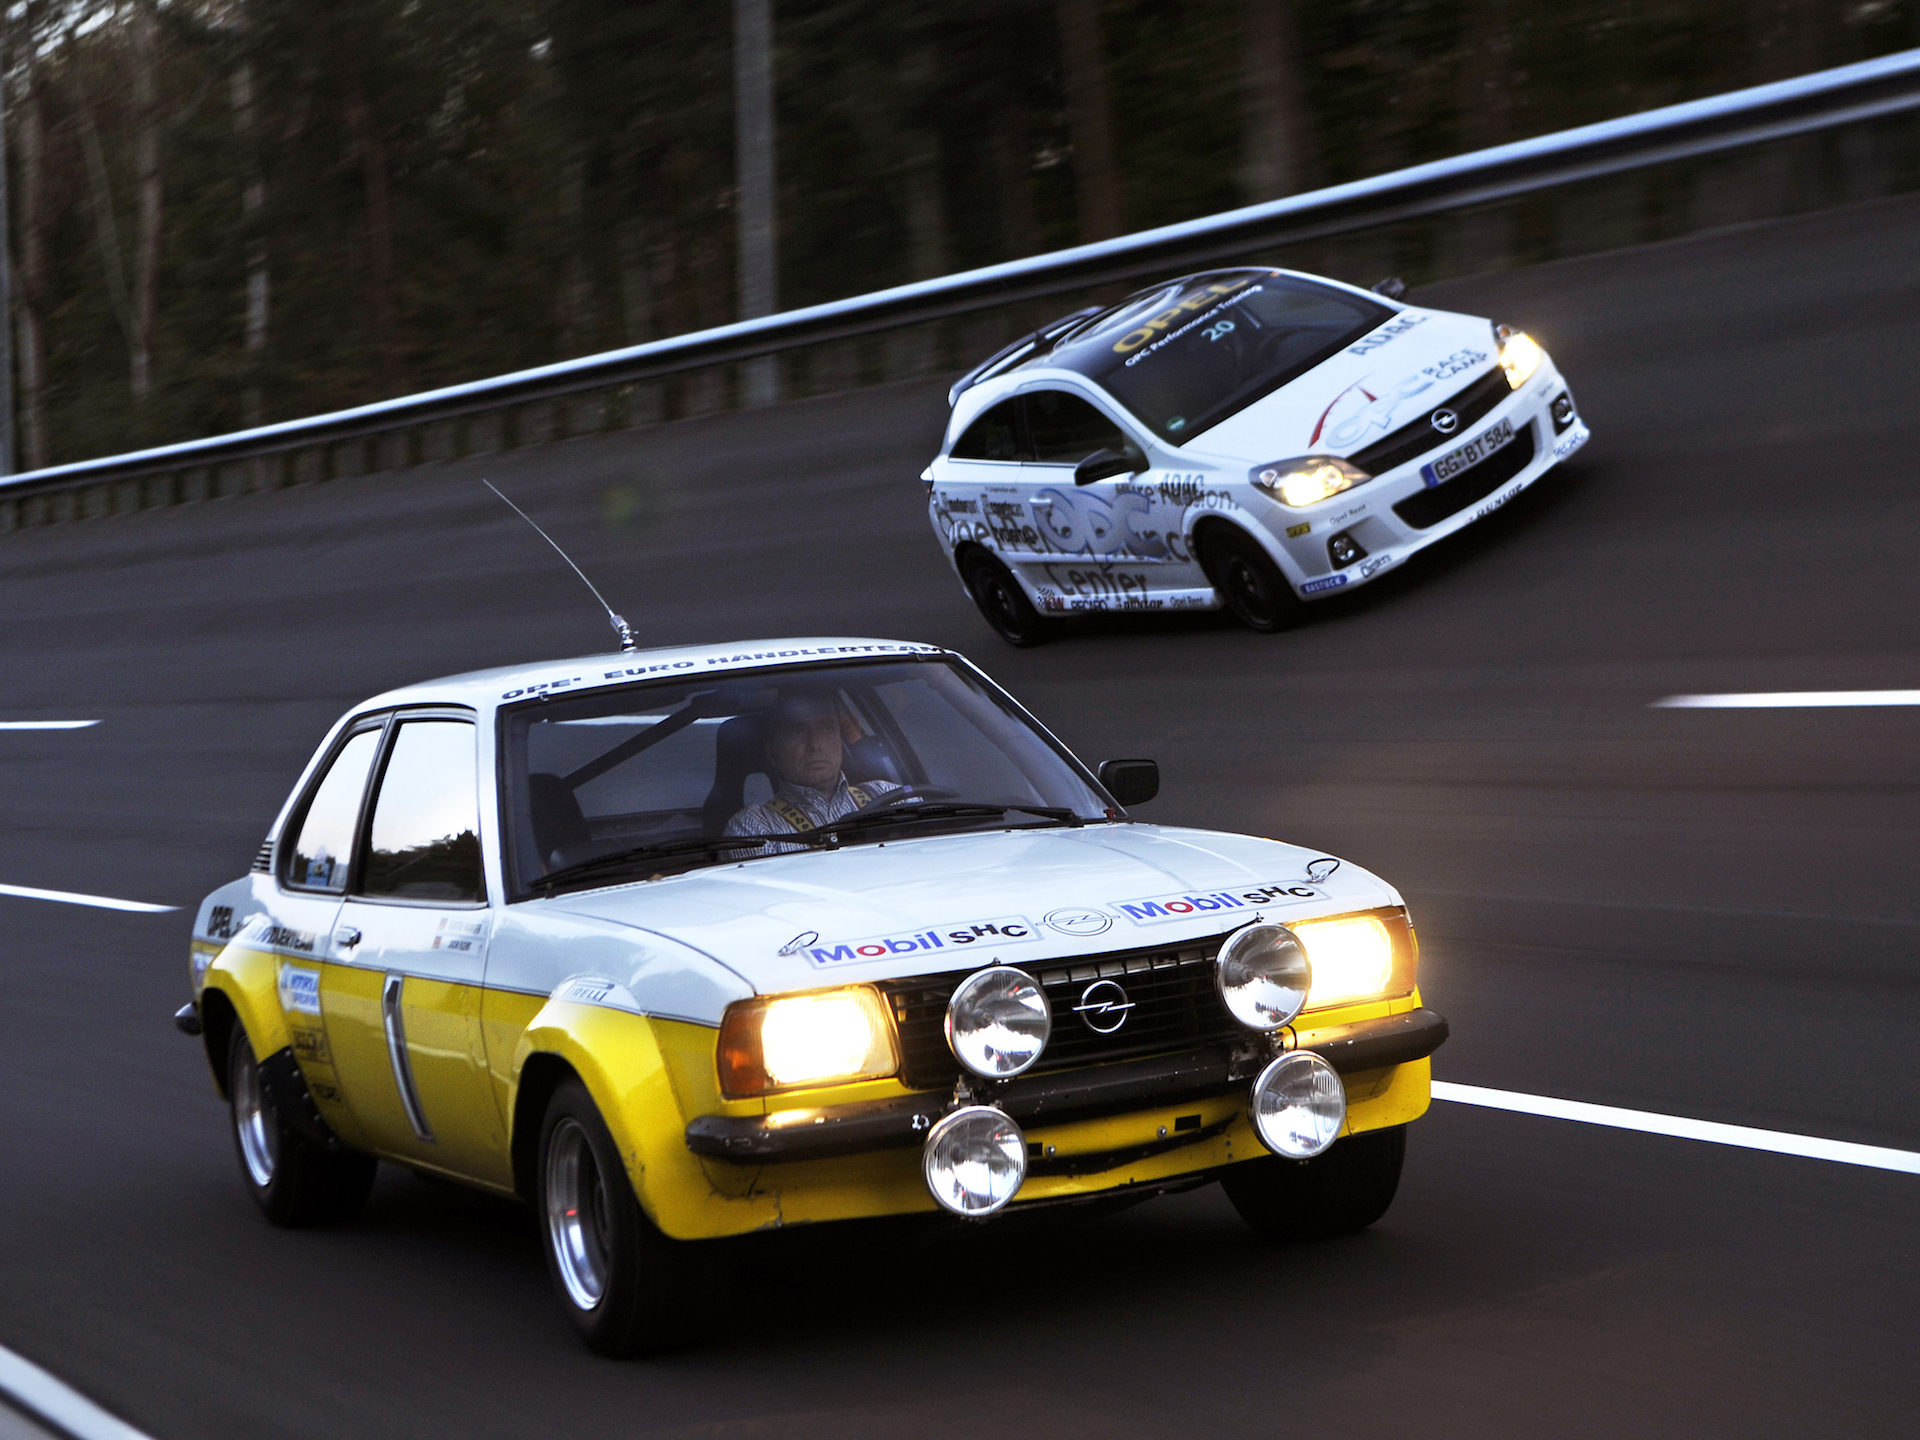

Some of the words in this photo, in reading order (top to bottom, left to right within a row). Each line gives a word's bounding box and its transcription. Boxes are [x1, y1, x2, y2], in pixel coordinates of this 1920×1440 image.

[1112, 279, 1248, 354] OPEL
[1124, 347, 1151, 367] OPC
[1149, 308, 1219, 353] Performance
[1217, 284, 1263, 310] Training
[1200, 320, 1235, 342] 20
[1348, 314, 1431, 356] ADAC
[1421, 347, 1475, 375] RACE
[1435, 353, 1487, 380] CAMP
[1434, 455, 1460, 480] GG
[1463, 438, 1486, 463] BT
[1485, 421, 1513, 449] 584
[1476, 482, 1522, 518] DUNLOP
[1044, 563, 1147, 602] Center
[1304, 576, 1341, 593] BASTUCK
[1124, 600, 1163, 610] DUNLOP
[502, 677, 581, 700] OPE
[604, 661, 694, 680] EURO
[1120, 891, 1244, 921] Mobil
[1243, 883, 1315, 907] SHC
[811, 929, 944, 965] Mobil
[948, 920, 1028, 945] SHC
